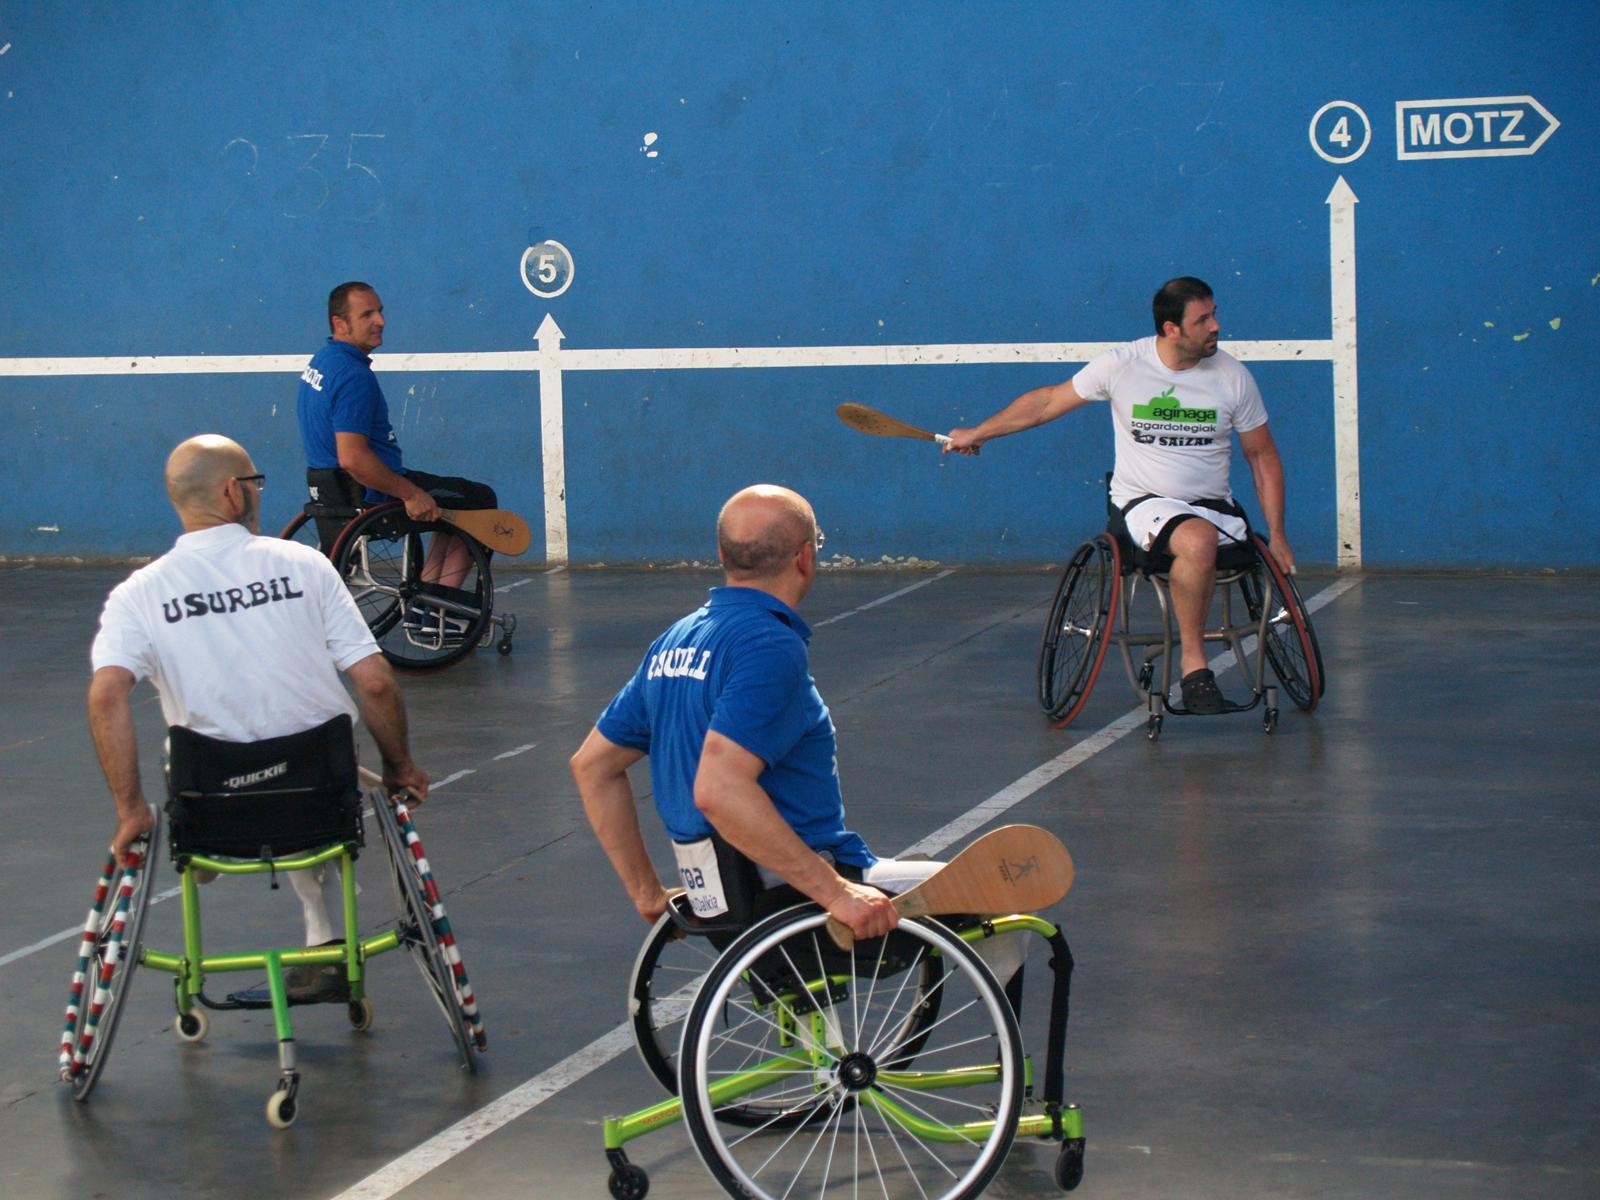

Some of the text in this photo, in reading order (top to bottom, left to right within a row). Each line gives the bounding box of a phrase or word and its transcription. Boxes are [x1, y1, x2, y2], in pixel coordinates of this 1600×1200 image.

[1329, 116, 1351, 148] 4
[1410, 110, 1526, 146] MOTZ
[538, 254, 557, 283] 5
[229, 761, 288, 788] QUICKIE
